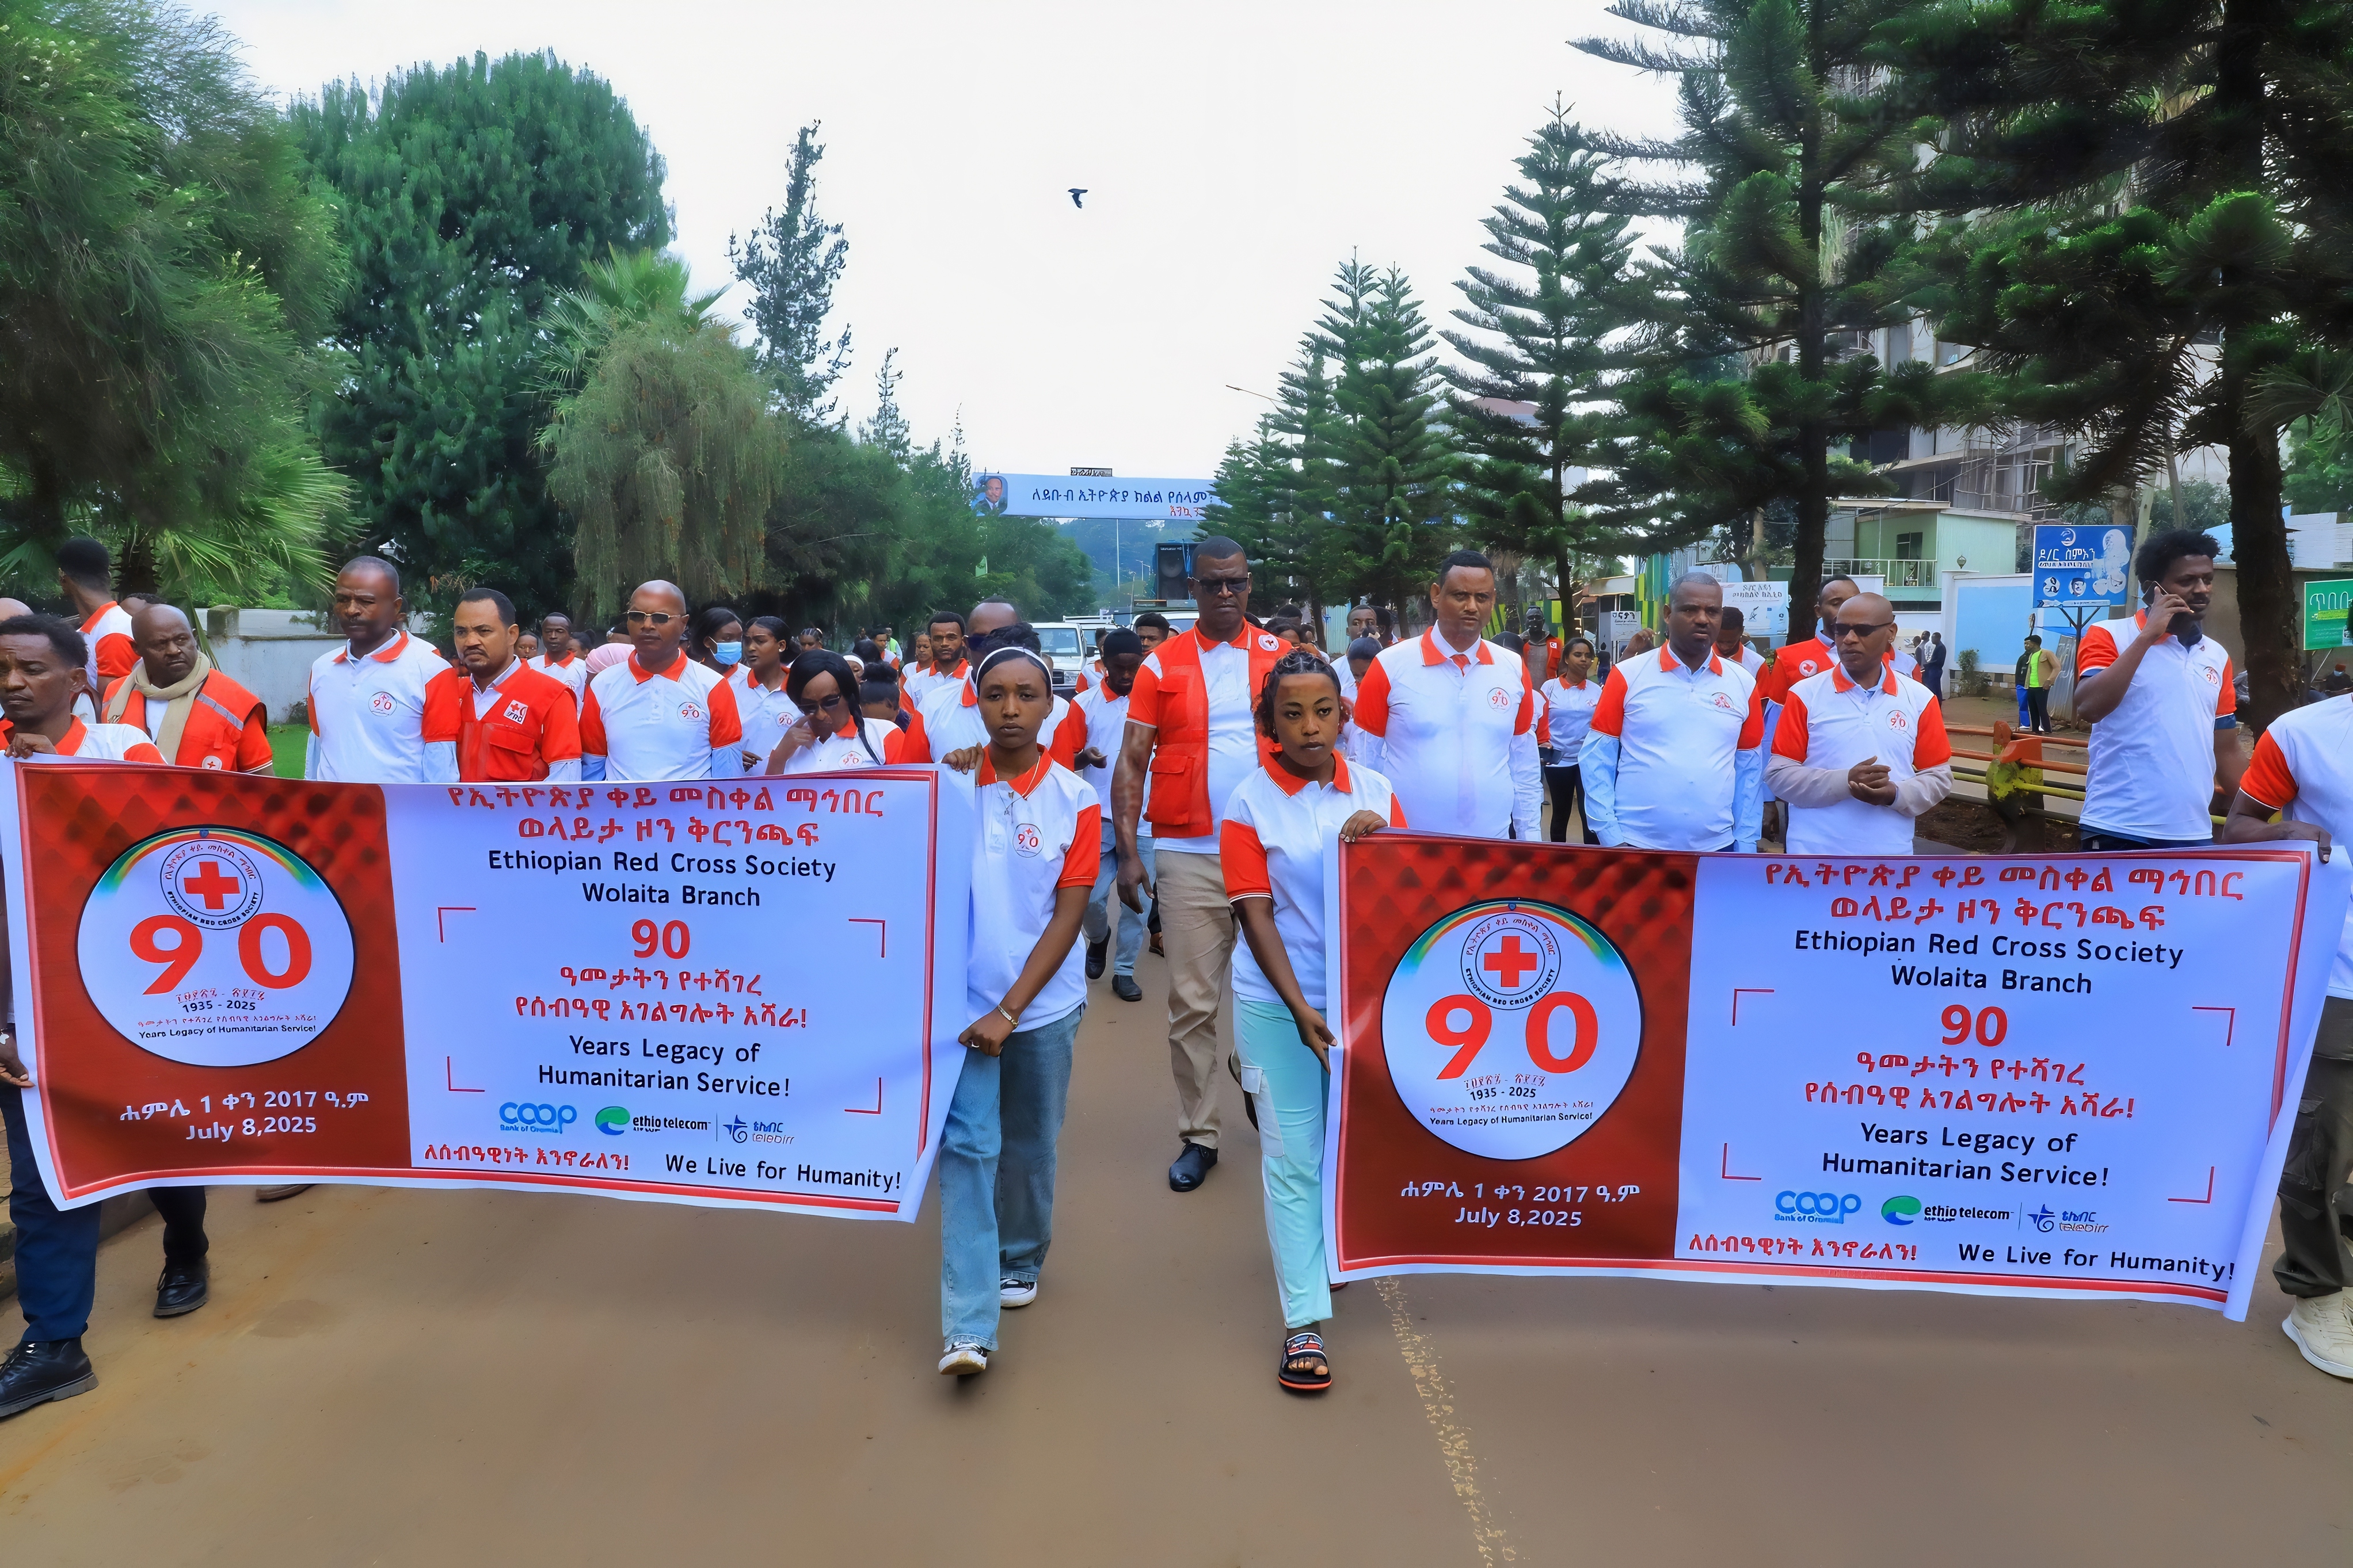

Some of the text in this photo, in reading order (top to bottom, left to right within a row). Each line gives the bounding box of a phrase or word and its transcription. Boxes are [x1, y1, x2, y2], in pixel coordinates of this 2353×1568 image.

[448, 787, 884, 817] የኢትዮጵያ ቀይ መስቀል ማኅበር
[519, 817, 818, 846] ወላይታ ዞን ቅርንጫፍ
[489, 850, 836, 882] Ethiopian Red Cross Society
[582, 883, 759, 906] Wolaita Branch
[1766, 864, 2243, 901] የኢትዮጵያ ቀይ መስቀል ማኅበር
[1831, 896, 2164, 930] ወላይታ ዞን ቅርንጫፍ
[631, 919, 690, 959] 90
[1796, 930, 2183, 969] Ethiopian Red Cross Society
[561, 967, 762, 996] ዓመታትን የተሻገረ
[1891, 965, 2091, 994] Wolaita Branch
[182, 1000, 256, 1012] 1935 2025
[1941, 1005, 2007, 1047] 90
[569, 1035, 760, 1065] Years Legacy of
[539, 1065, 789, 1096] Humanitarian Service!
[1857, 1052, 2085, 1085] ዓመታትን የተሻገረ
[120, 1099, 190, 1120] ሐምሌ
[201, 1096, 211, 1113] 1
[223, 1092, 255, 1110] ቀን
[264, 1091, 317, 1107] 2017
[1471, 1087, 1536, 1100] 1935 2025
[186, 1116, 316, 1142] July 8,2025
[633, 1116, 707, 1131] ethio telecom
[1861, 1123, 2078, 1155] Years Legacy of
[425, 1144, 628, 1170] ለሰብዓዊነት እንኖራለን!
[1823, 1153, 2108, 1186] Humanitarian Service!
[666, 1154, 900, 1193] We Live for Humanity!
[1402, 1181, 1464, 1197] ሐምሌ
[1475, 1184, 1483, 1198] 1
[1494, 1185, 1525, 1200] ቀን
[1533, 1187, 1588, 1202] 2017
[1455, 1207, 1581, 1227] July 8,2025
[1924, 1205, 2009, 1220] ethio telecom
[1689, 1234, 1916, 1260] ለሰብዓዊነት እንኖራለን!
[1959, 1244, 2234, 1281] We Live for Humanity!
